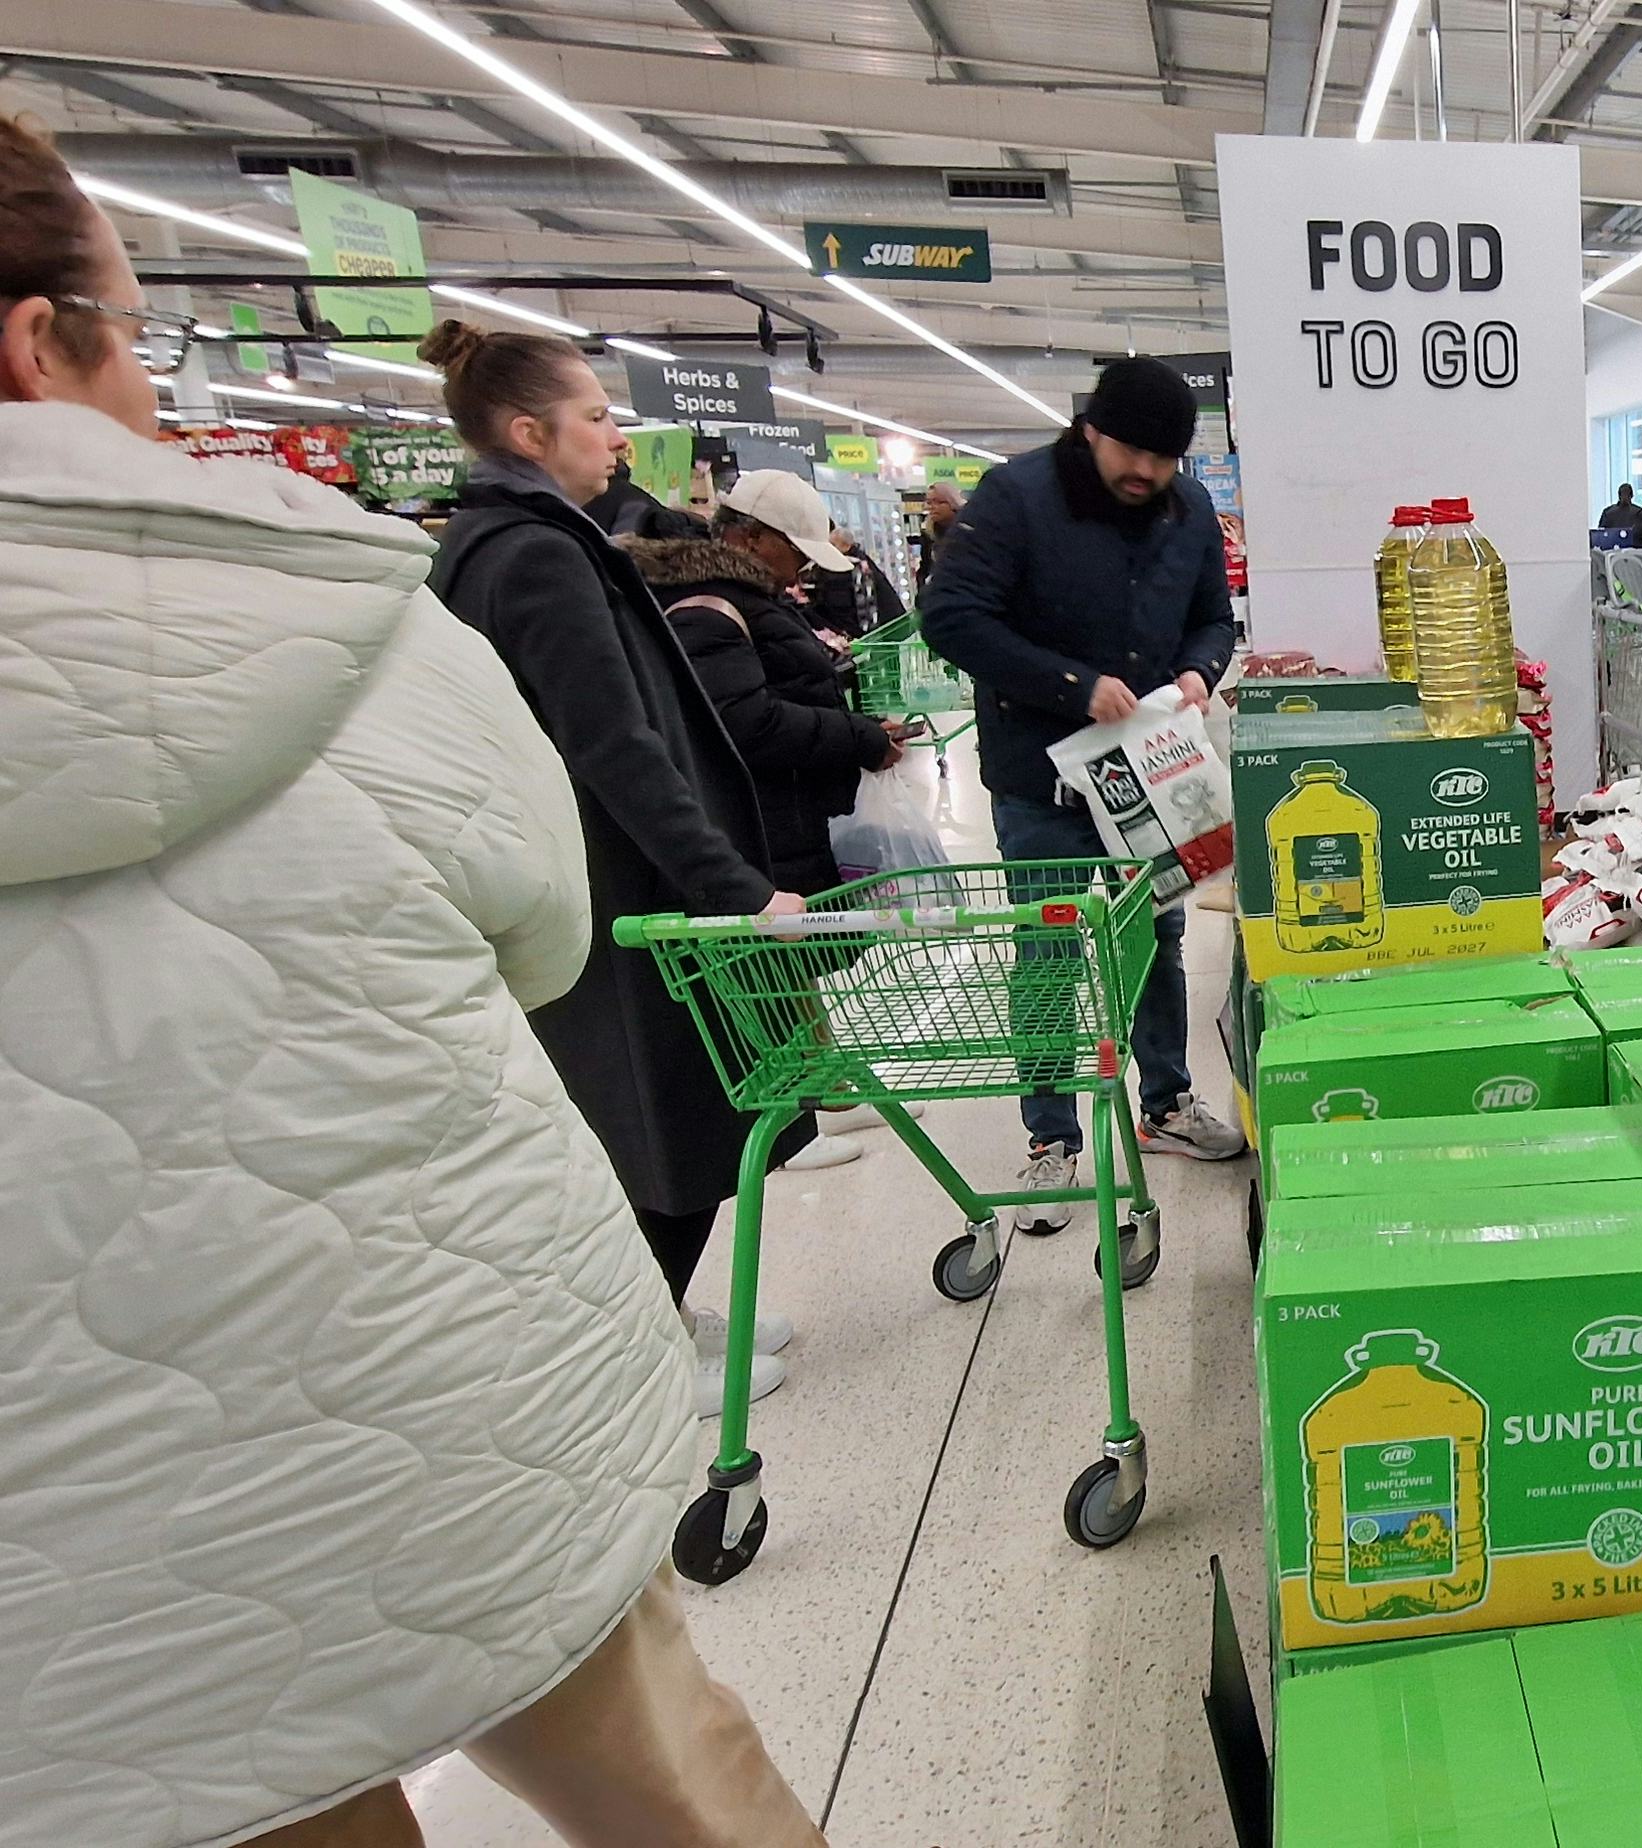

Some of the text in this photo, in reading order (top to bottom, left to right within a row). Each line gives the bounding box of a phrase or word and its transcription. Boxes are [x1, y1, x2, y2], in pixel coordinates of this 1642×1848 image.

[862, 242, 974, 269] SUBWAY
[1307, 220, 1502, 293] FOOD
[1301, 320, 1519, 389] TO GO
[663, 367, 739, 390] Herbs &
[1186, 371, 1215, 388] ices
[673, 393, 738, 415] Spices
[748, 424, 800, 438] Frozen
[200, 431, 272, 454] Quality
[383, 446, 408, 465] of
[413, 447, 465, 469] your
[411, 465, 455, 486] day
[1248, 689, 1273, 699] PACK
[1237, 754, 1279, 767] 3 PACK
[1437, 774, 1483, 797] KTC
[1410, 811, 1511, 830] EXTENDED LIFE
[1401, 826, 1523, 852] VEGETABLE
[1444, 849, 1482, 868] OIL
[800, 912, 846, 925] HANDLE
[1432, 925, 1440, 935] 3
[1450, 924, 1457, 933] 5
[1459, 922, 1483, 932] Litre
[1406, 946, 1436, 958] JUL
[1446, 941, 1487, 955] 2027
[1264, 1070, 1309, 1085] 3 PACK
[1478, 1083, 1533, 1108] KTC
[1279, 1303, 1342, 1322] 3 PACK
[1364, 1475, 1433, 1492] SUNFLOWER
[1526, 1487, 1547, 1499] FOR
[1550, 1485, 1569, 1497] ALL
[1571, 1481, 1616, 1494] FRYING,
[1389, 1490, 1408, 1500] OIL
[1551, 1580, 1566, 1601] 3
[1571, 1582, 1586, 1599] x
[1593, 1577, 1606, 1597] 5
